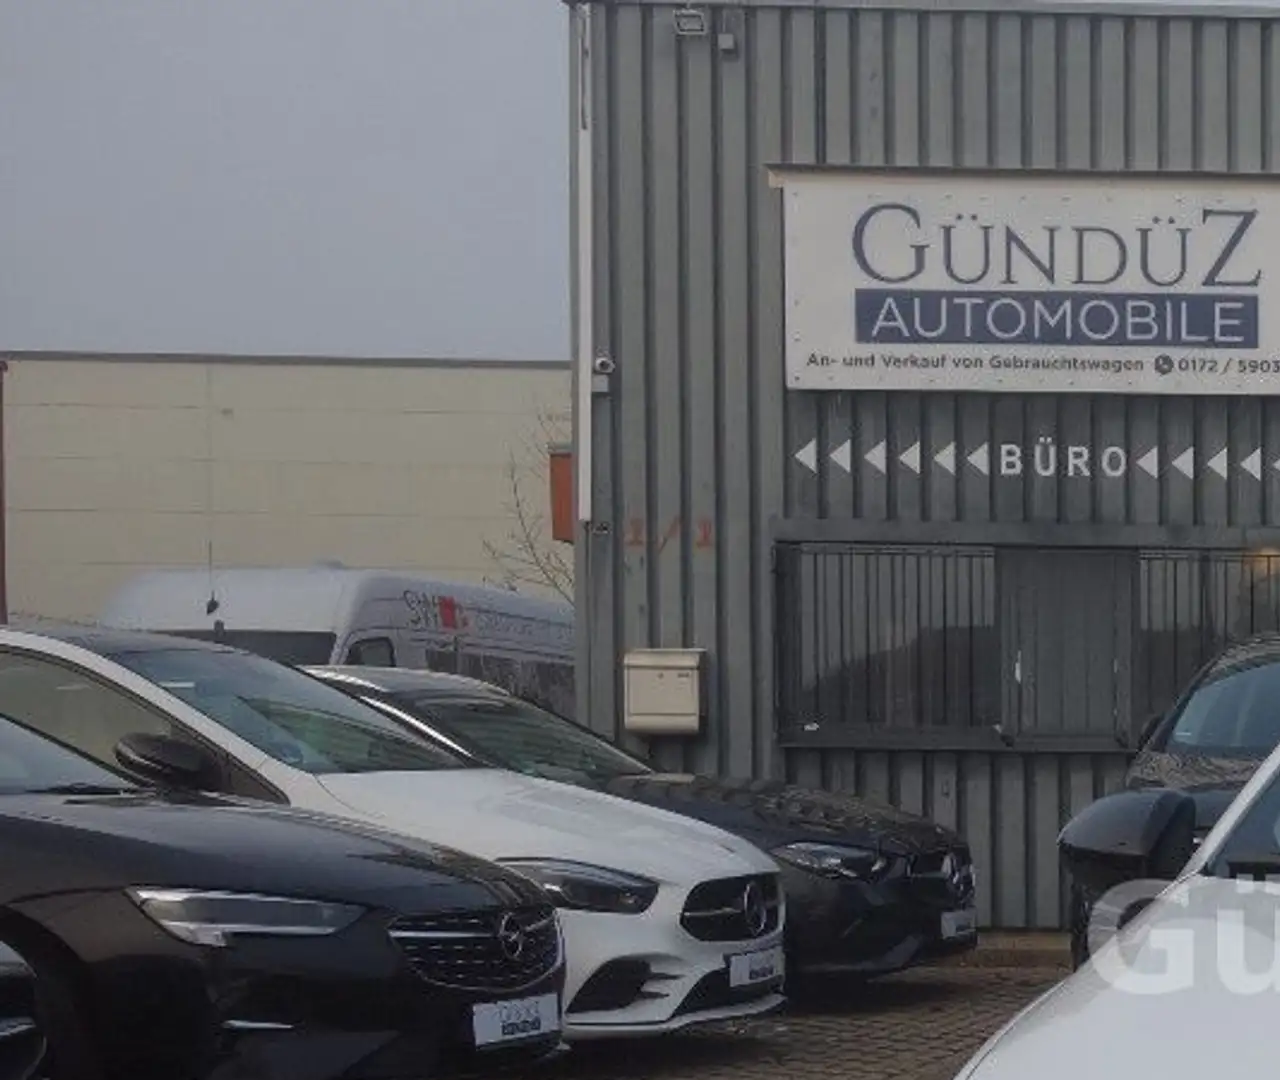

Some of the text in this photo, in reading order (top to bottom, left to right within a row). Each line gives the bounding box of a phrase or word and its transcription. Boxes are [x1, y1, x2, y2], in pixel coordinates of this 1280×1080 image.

[871, 296, 1245, 342] AUTOMOBILE
[806, 352, 837, 367] An-
[843, 353, 876, 368] und
[881, 354, 948, 369] Verkauf
[952, 357, 984, 369] von
[988, 356, 1145, 375] Gebrauchtswagen
[1178, 359, 1219, 373] 0172
[1000, 436, 1127, 477] BÜRO
